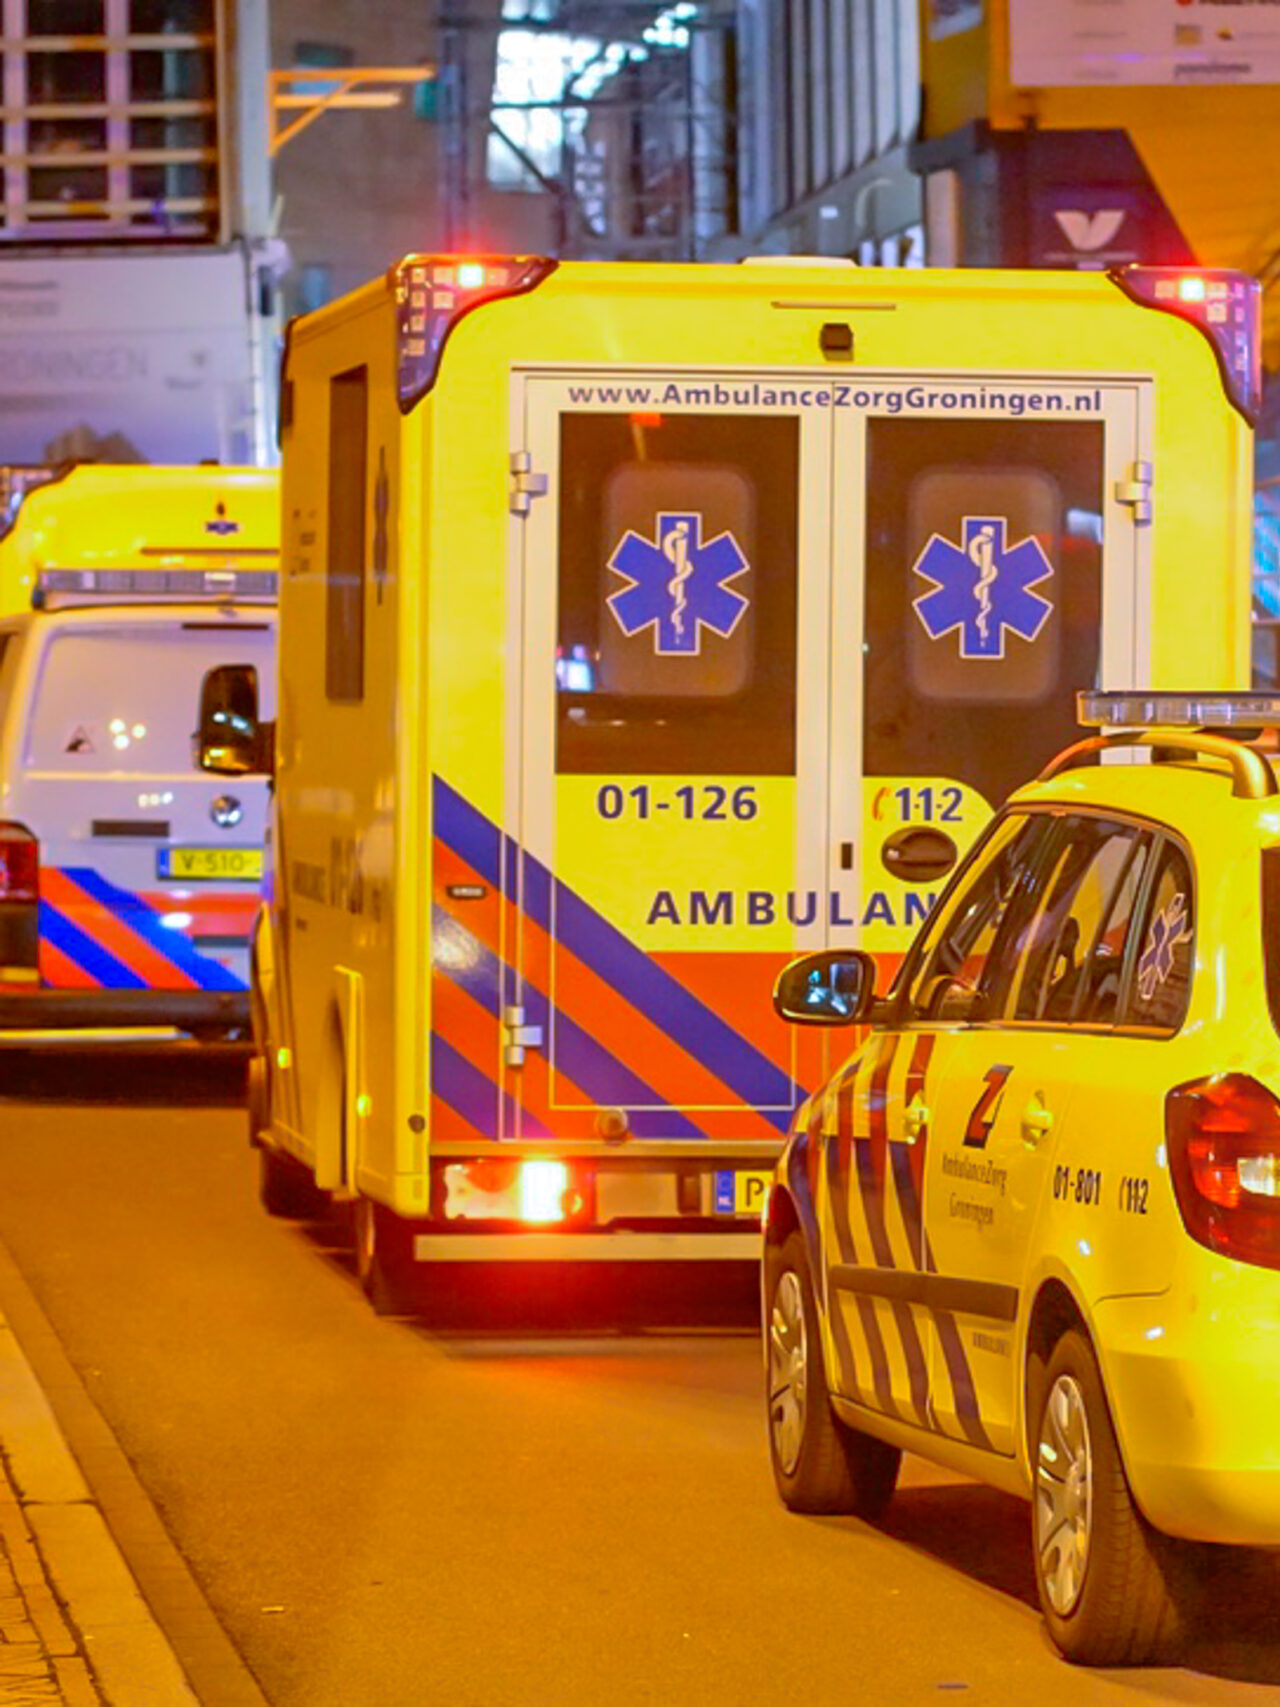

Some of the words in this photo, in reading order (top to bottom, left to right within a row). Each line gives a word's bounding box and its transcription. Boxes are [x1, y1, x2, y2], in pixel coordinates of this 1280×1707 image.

[568, 383, 1101, 415] www.AmbulanceZorgGroningen.nl
[597, 785, 758, 820] 01-126
[646, 890, 938, 926] AMBULAN
[1053, 1164, 1101, 1206] 01-801
